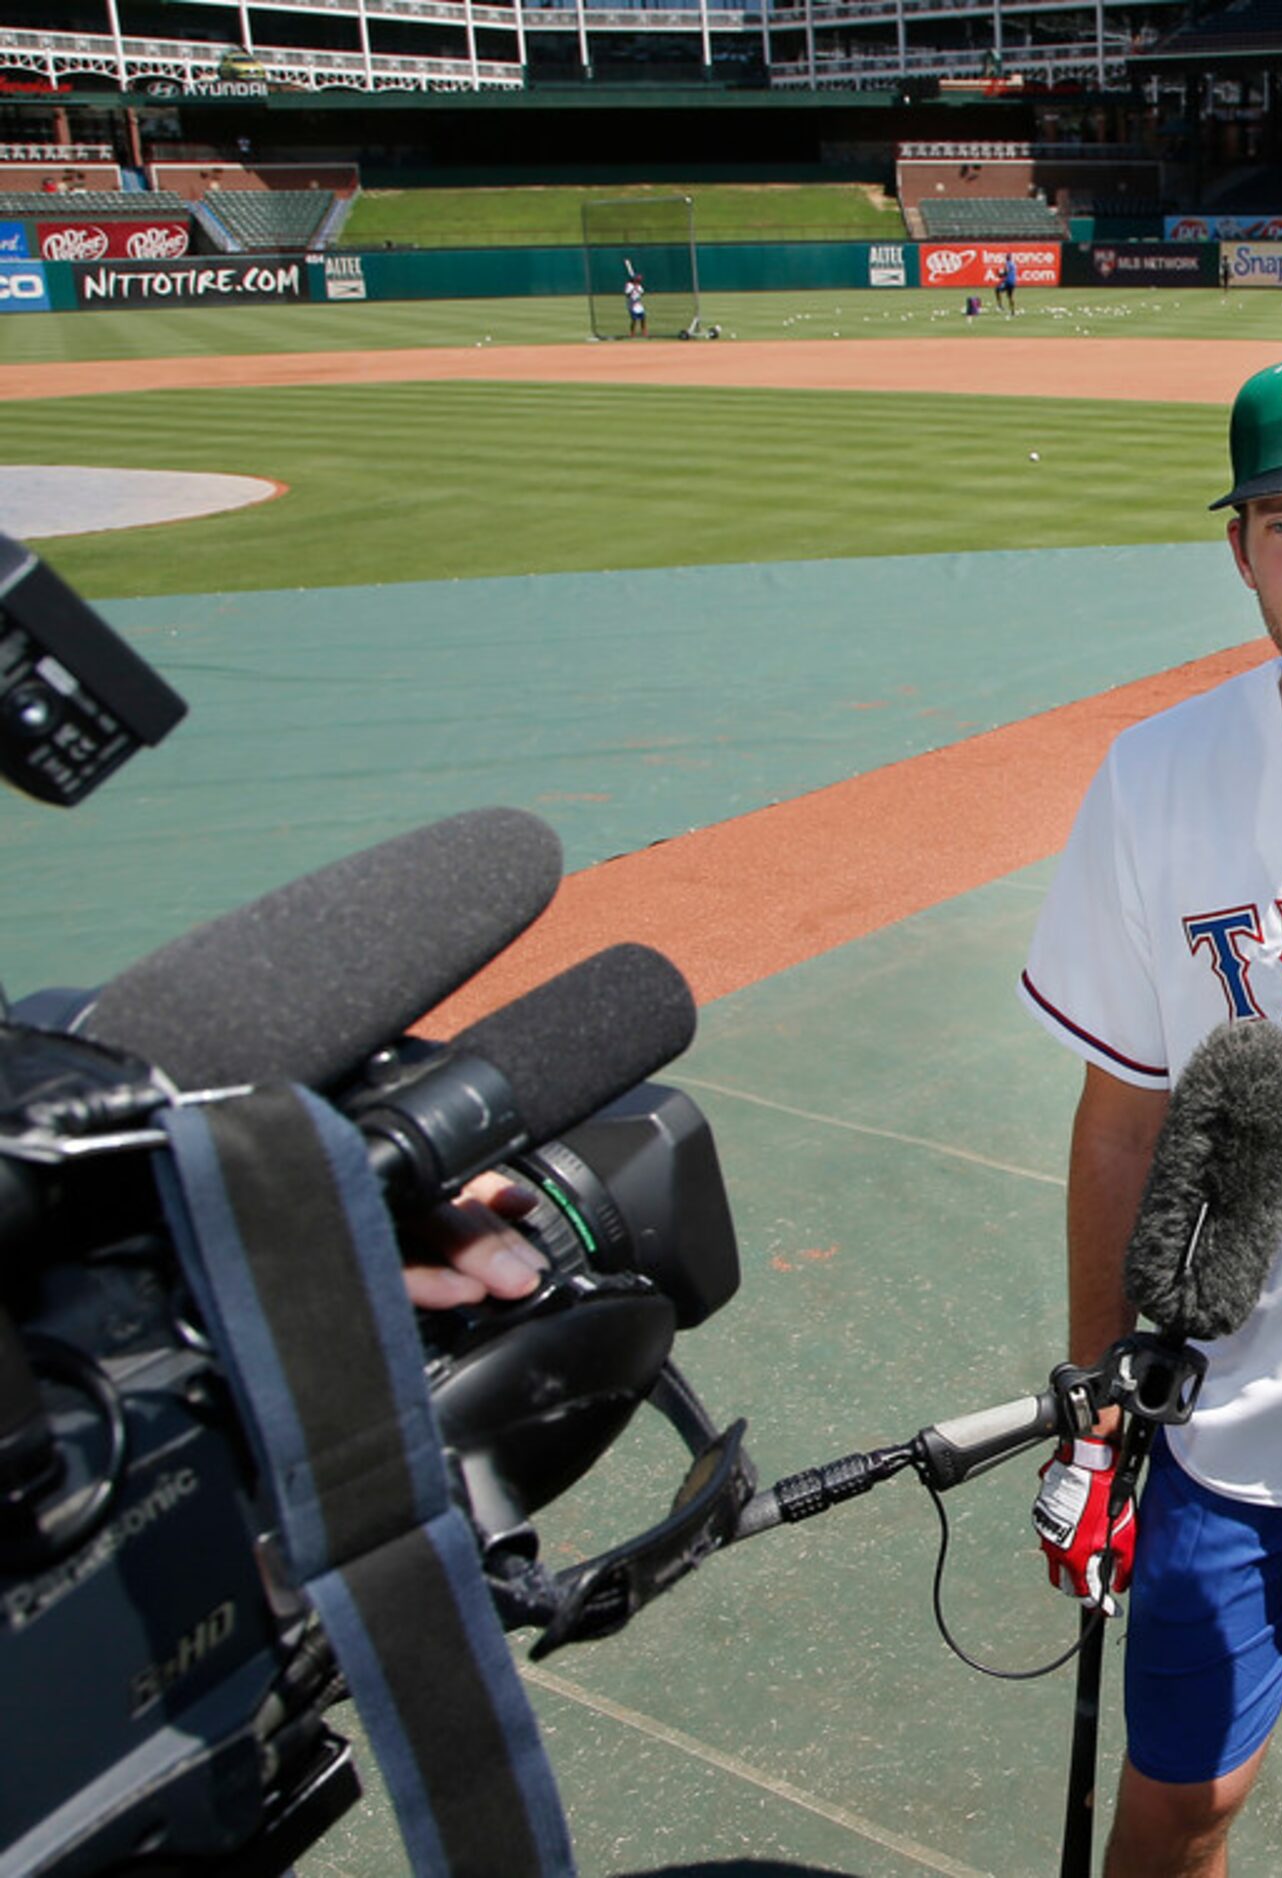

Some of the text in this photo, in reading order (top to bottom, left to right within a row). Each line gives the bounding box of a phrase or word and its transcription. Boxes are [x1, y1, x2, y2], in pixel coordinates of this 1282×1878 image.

[183, 82, 269, 97] HYUNDAI
[982, 249, 1055, 265] Insrance
[1144, 257, 1199, 271] NETWORK
[85, 265, 300, 299] NITTOTIRE.COM
